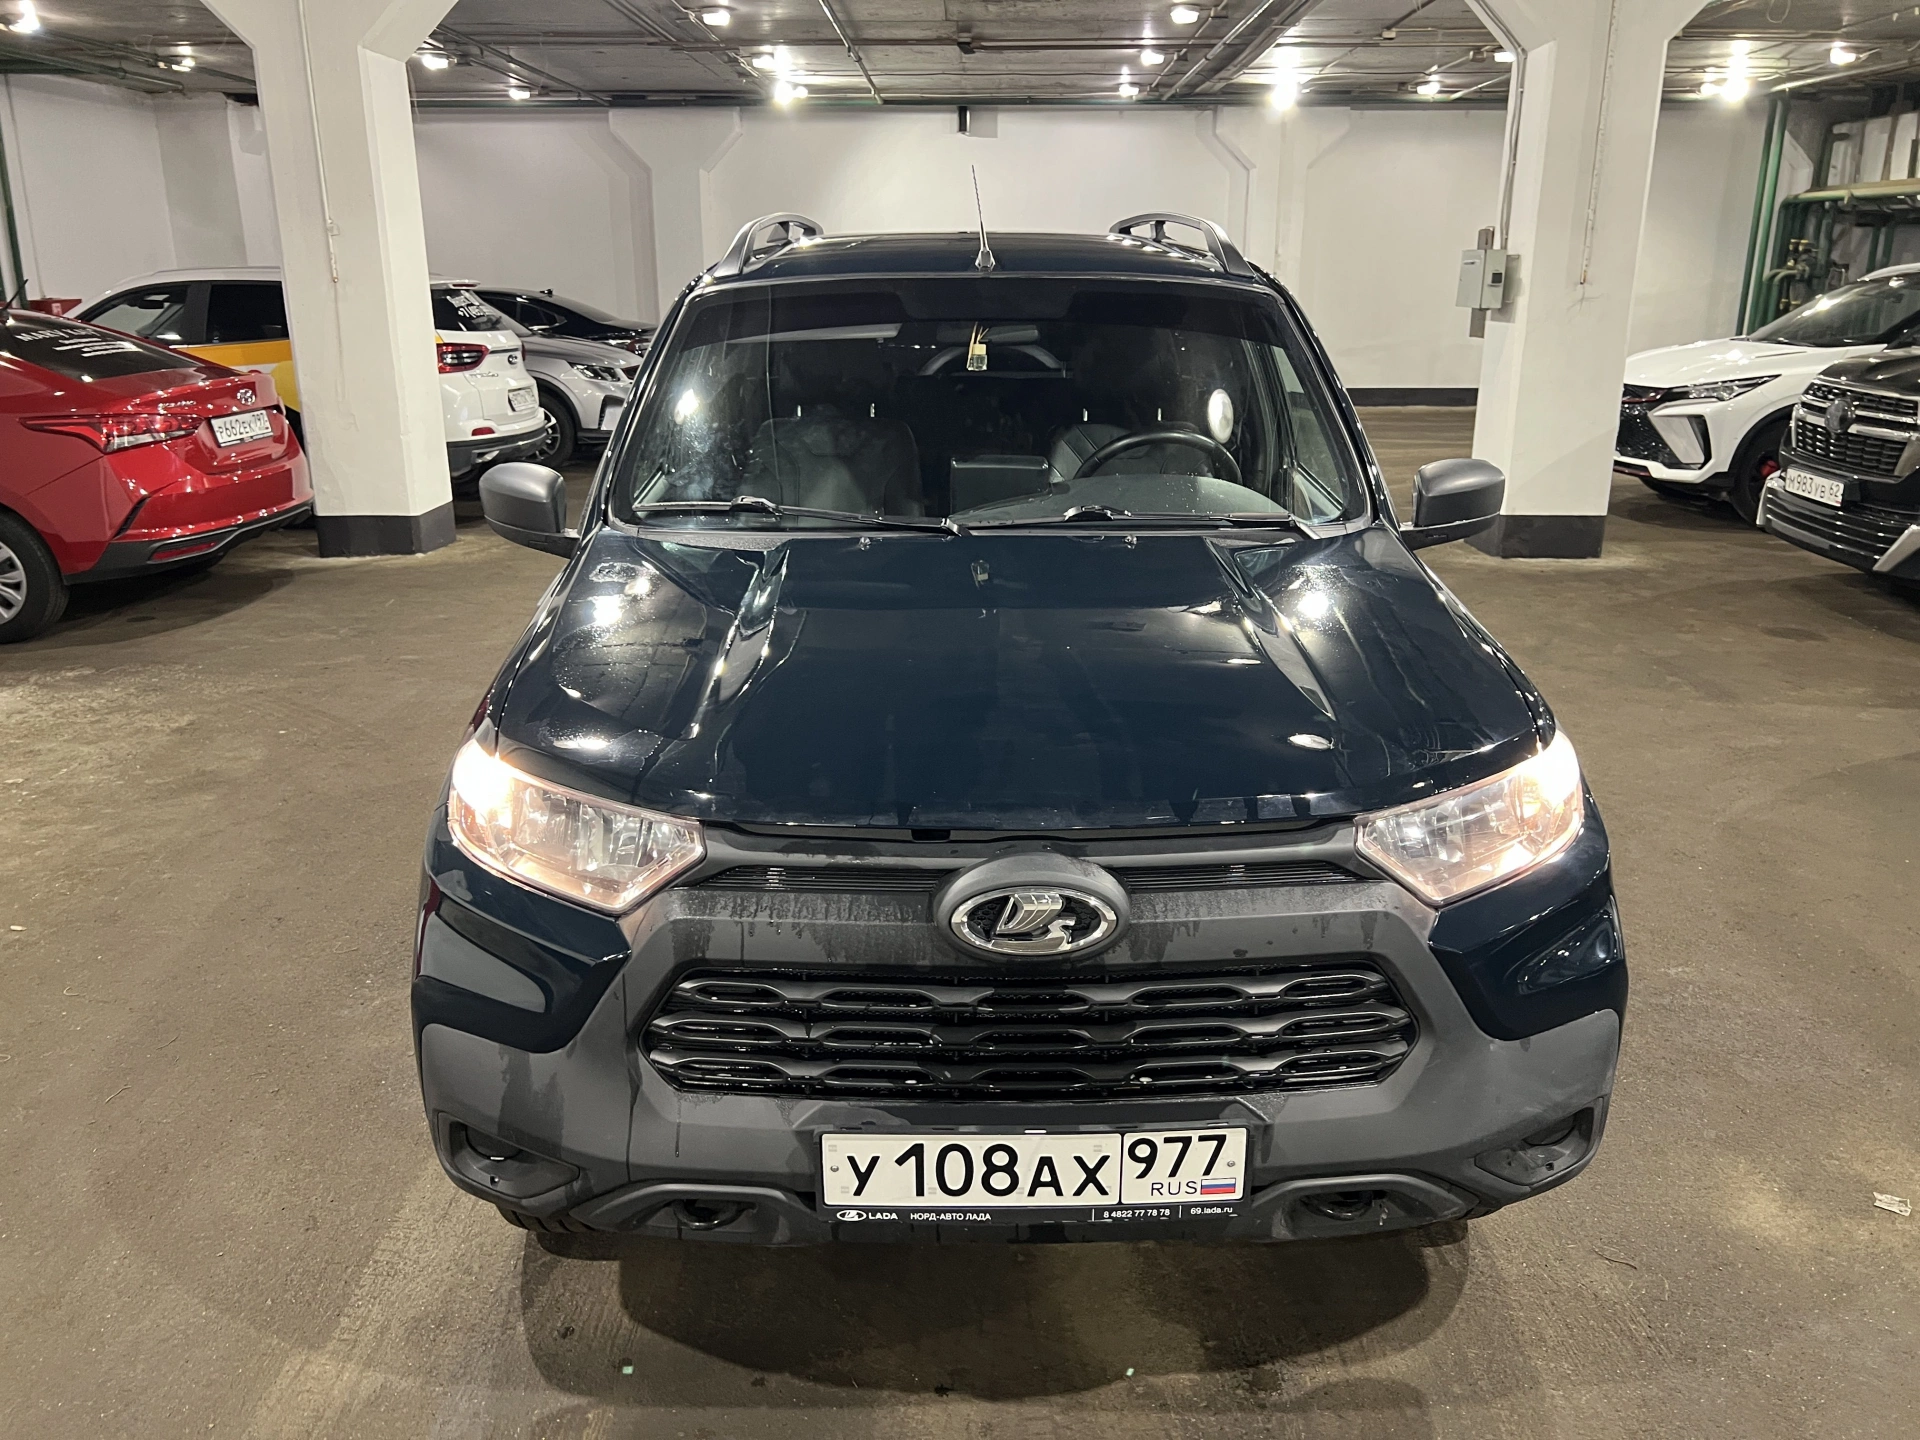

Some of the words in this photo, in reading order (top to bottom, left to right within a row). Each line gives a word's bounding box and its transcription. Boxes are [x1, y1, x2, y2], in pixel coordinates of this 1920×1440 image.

[1829, 482, 1841, 498] 62
[1127, 1134, 1228, 1180] 977
[1151, 1180, 1198, 1197] RUS
[1111, 1210, 1133, 1218] 4822
[1134, 1209, 1145, 1217] 77
[1146, 1209, 1158, 1217] 78
[1159, 1208, 1170, 1216] 78
[1190, 1206, 1233, 1215] 69.lada.ru
[869, 1212, 898, 1220] LADA
[910, 1212, 964, 1221] НОРД-АВТО
[965, 1212, 991, 1221] ЛАДА
